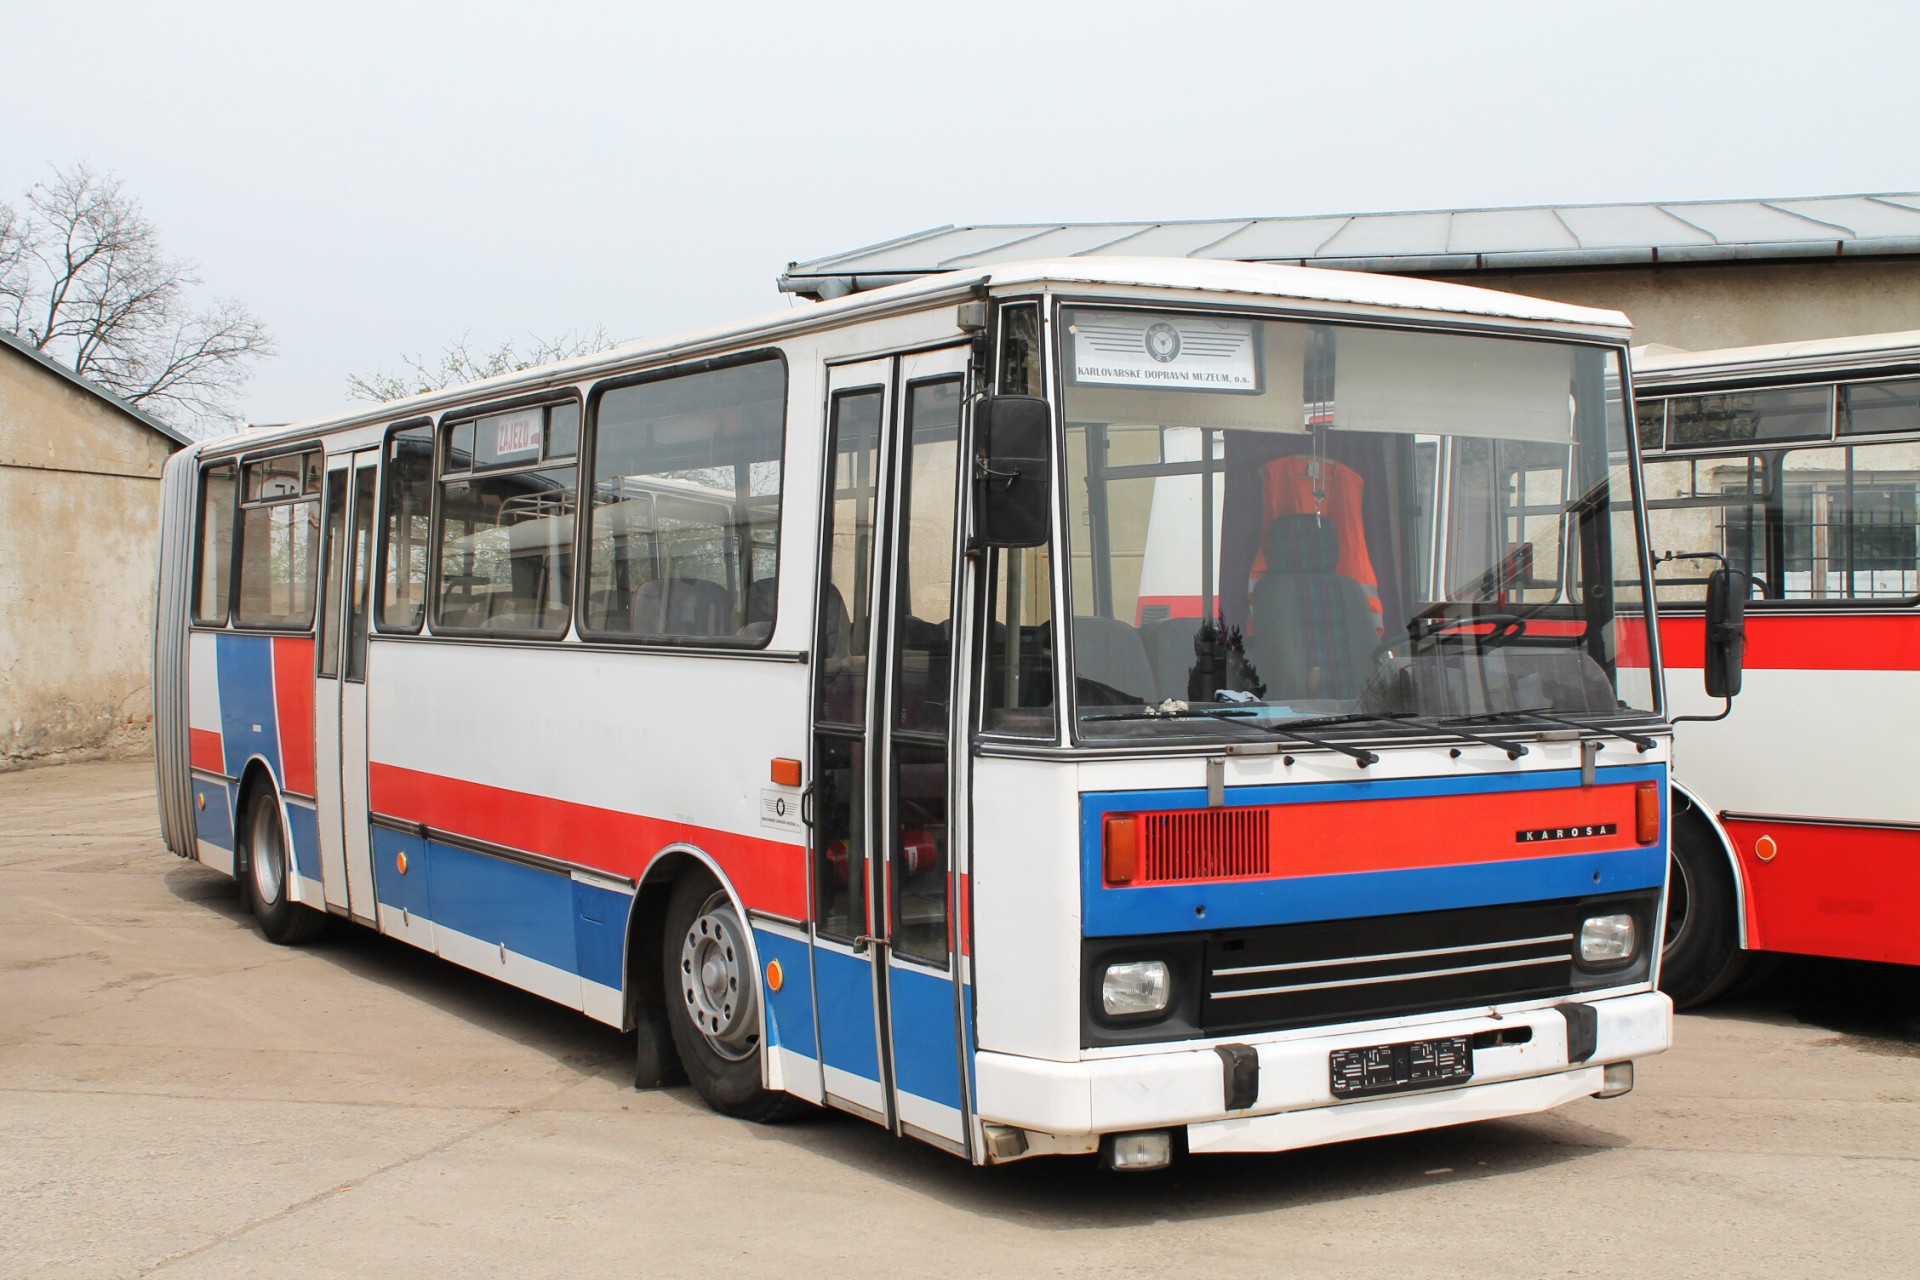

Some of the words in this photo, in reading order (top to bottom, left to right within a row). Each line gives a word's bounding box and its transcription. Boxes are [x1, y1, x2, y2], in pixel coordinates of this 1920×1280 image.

[1077, 365, 1142, 379] KARLOVARSKÉ
[1144, 368, 1190, 381] DOPRAVNÍ
[1192, 371, 1232, 384] MUZEUM,
[1234, 376, 1250, 384] o.s.
[1526, 825, 1607, 841] KAROSA
